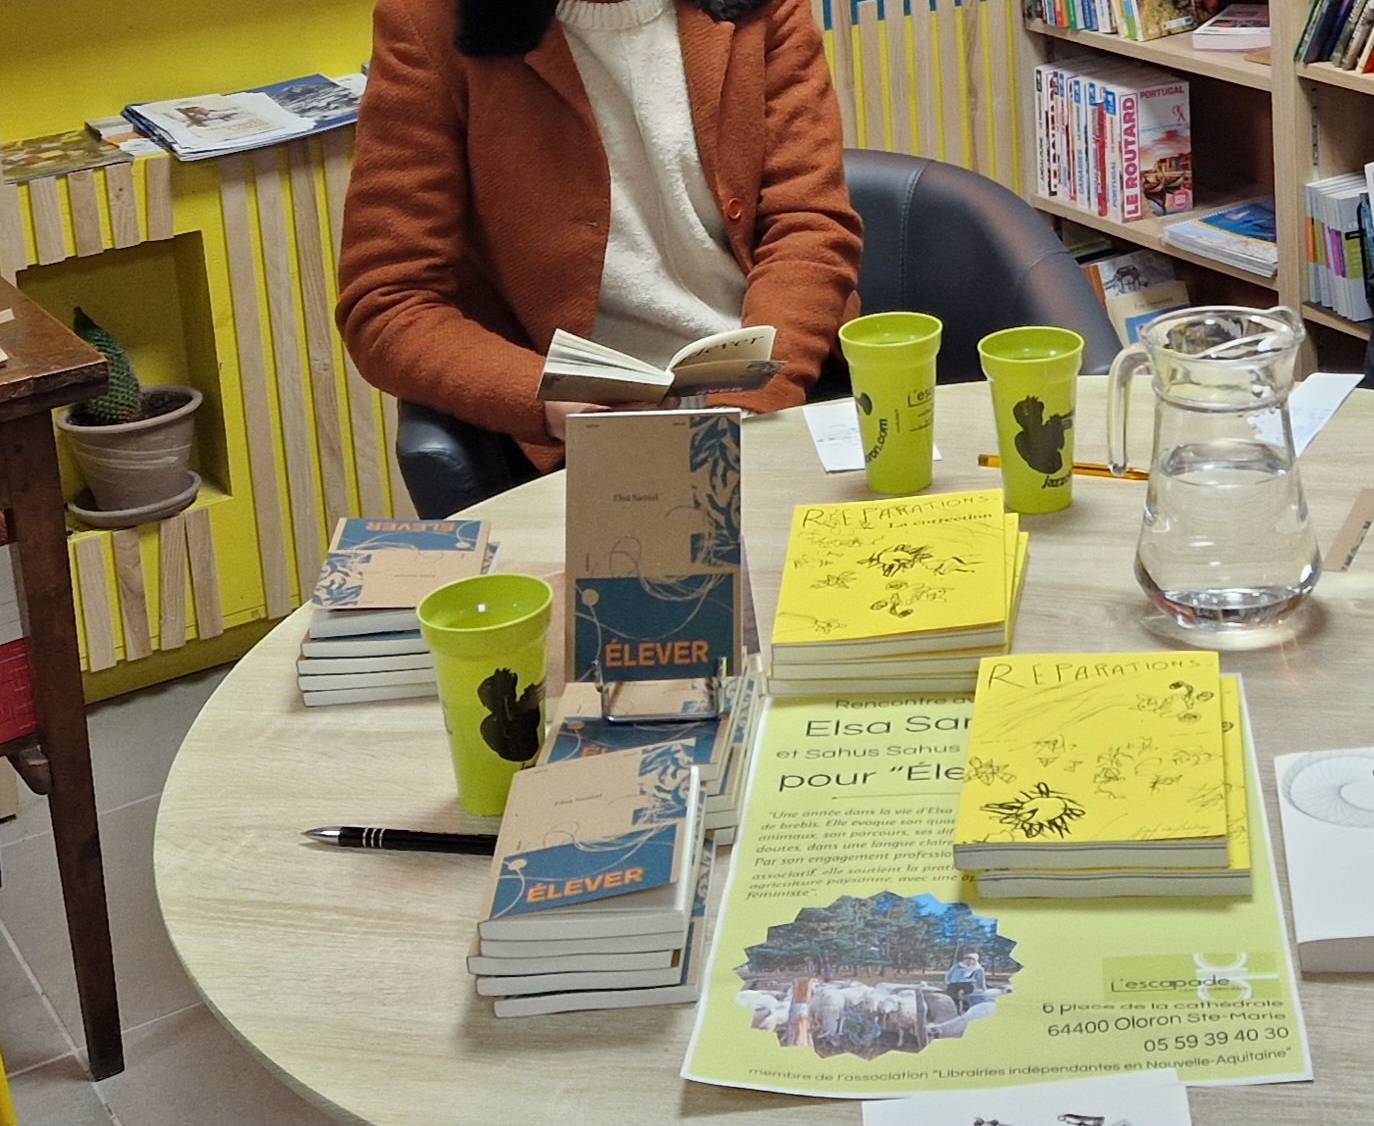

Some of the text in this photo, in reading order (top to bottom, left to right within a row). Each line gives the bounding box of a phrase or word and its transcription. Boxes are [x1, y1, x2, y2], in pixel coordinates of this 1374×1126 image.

[1139, 86, 1184, 99] PORTUGAL
[1122, 96, 1140, 216] LE ROUTARD
[365, 520, 455, 534] ÉLEVER
[604, 639, 709, 668] ÉLEVER
[835, 696, 948, 710] Rencontre
[806, 719, 892, 737] Elsa
[776, 744, 961, 761] et Sahus Sahus
[778, 771, 877, 792] pour
[802, 808, 875, 818] année dans
[851, 817, 897, 827] évoque
[807, 839, 915, 852] dans une langue
[754, 852, 890, 867] Par engagement
[848, 865, 902, 875] soutient
[525, 866, 645, 904] ÉLEVER
[749, 877, 824, 890] agriculture
[1110, 974, 1231, 993] L'escapade
[1042, 998, 1285, 1016] 6 place de la cathédrale
[1047, 1010, 1287, 1038] 64400 Oloron Ste-Marie
[1143, 1026, 1290, 1053] 05 59 39 40 30
[748, 1058, 1143, 1083] membre de l'association indépendantes en
